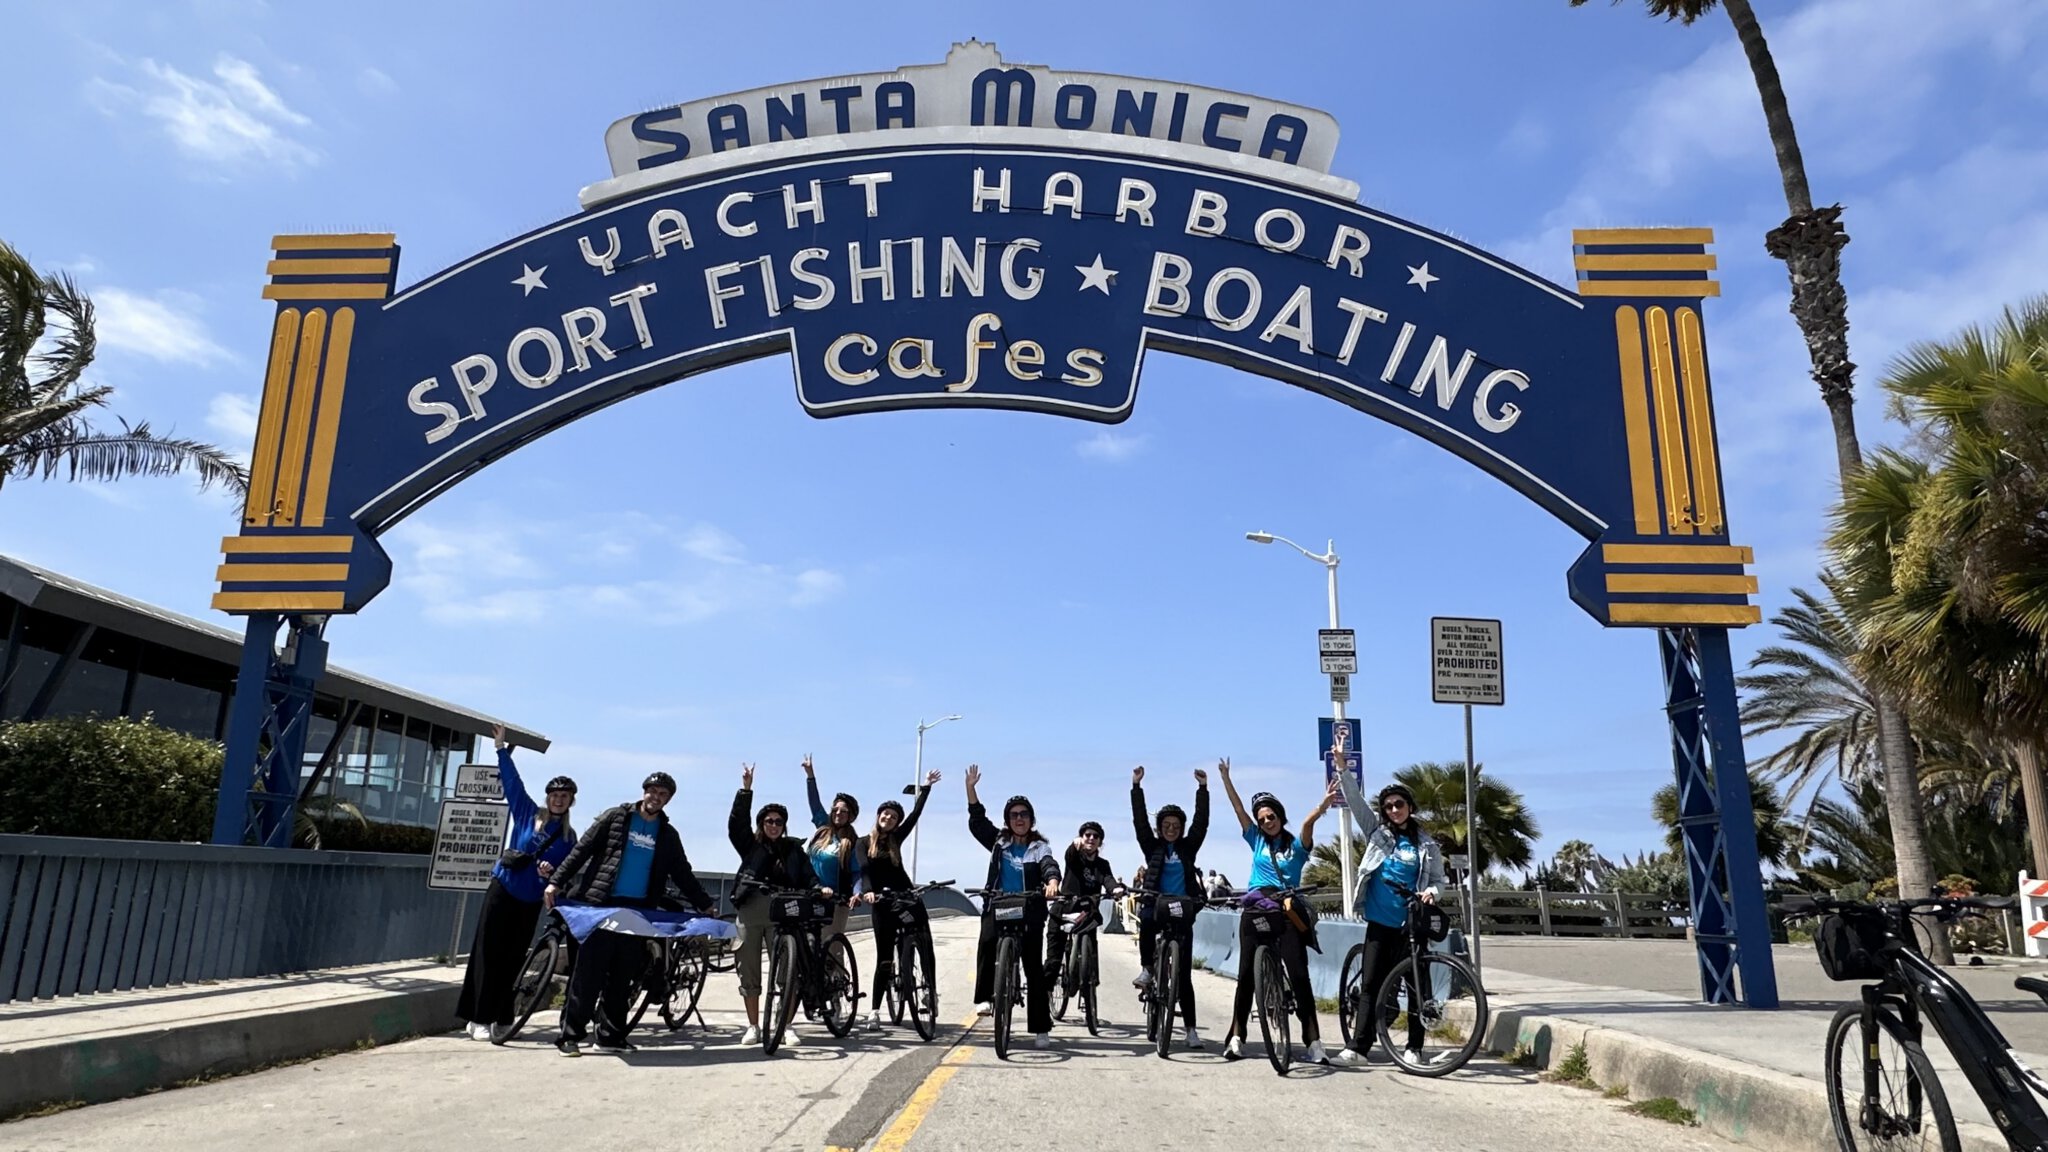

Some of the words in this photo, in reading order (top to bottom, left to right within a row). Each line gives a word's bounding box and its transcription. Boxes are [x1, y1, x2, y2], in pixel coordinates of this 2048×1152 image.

[630, 81, 915, 169] SANTA
[970, 68, 1308, 163] MONICA
[577, 172, 892, 276] YACHT
[972, 167, 1370, 278] HARBOR
[407, 282, 657, 444] SPORT
[704, 236, 1045, 329] FISHING
[1144, 251, 1530, 434] BOATING
[824, 313, 1106, 393] cafes
[1437, 657, 1498, 670] PROHIBITED
[1333, 676, 1346, 685] NO
[475, 770, 489, 780] USE
[458, 783, 502, 795] CROSSWALK
[439, 842, 499, 855] PROHIBITED
